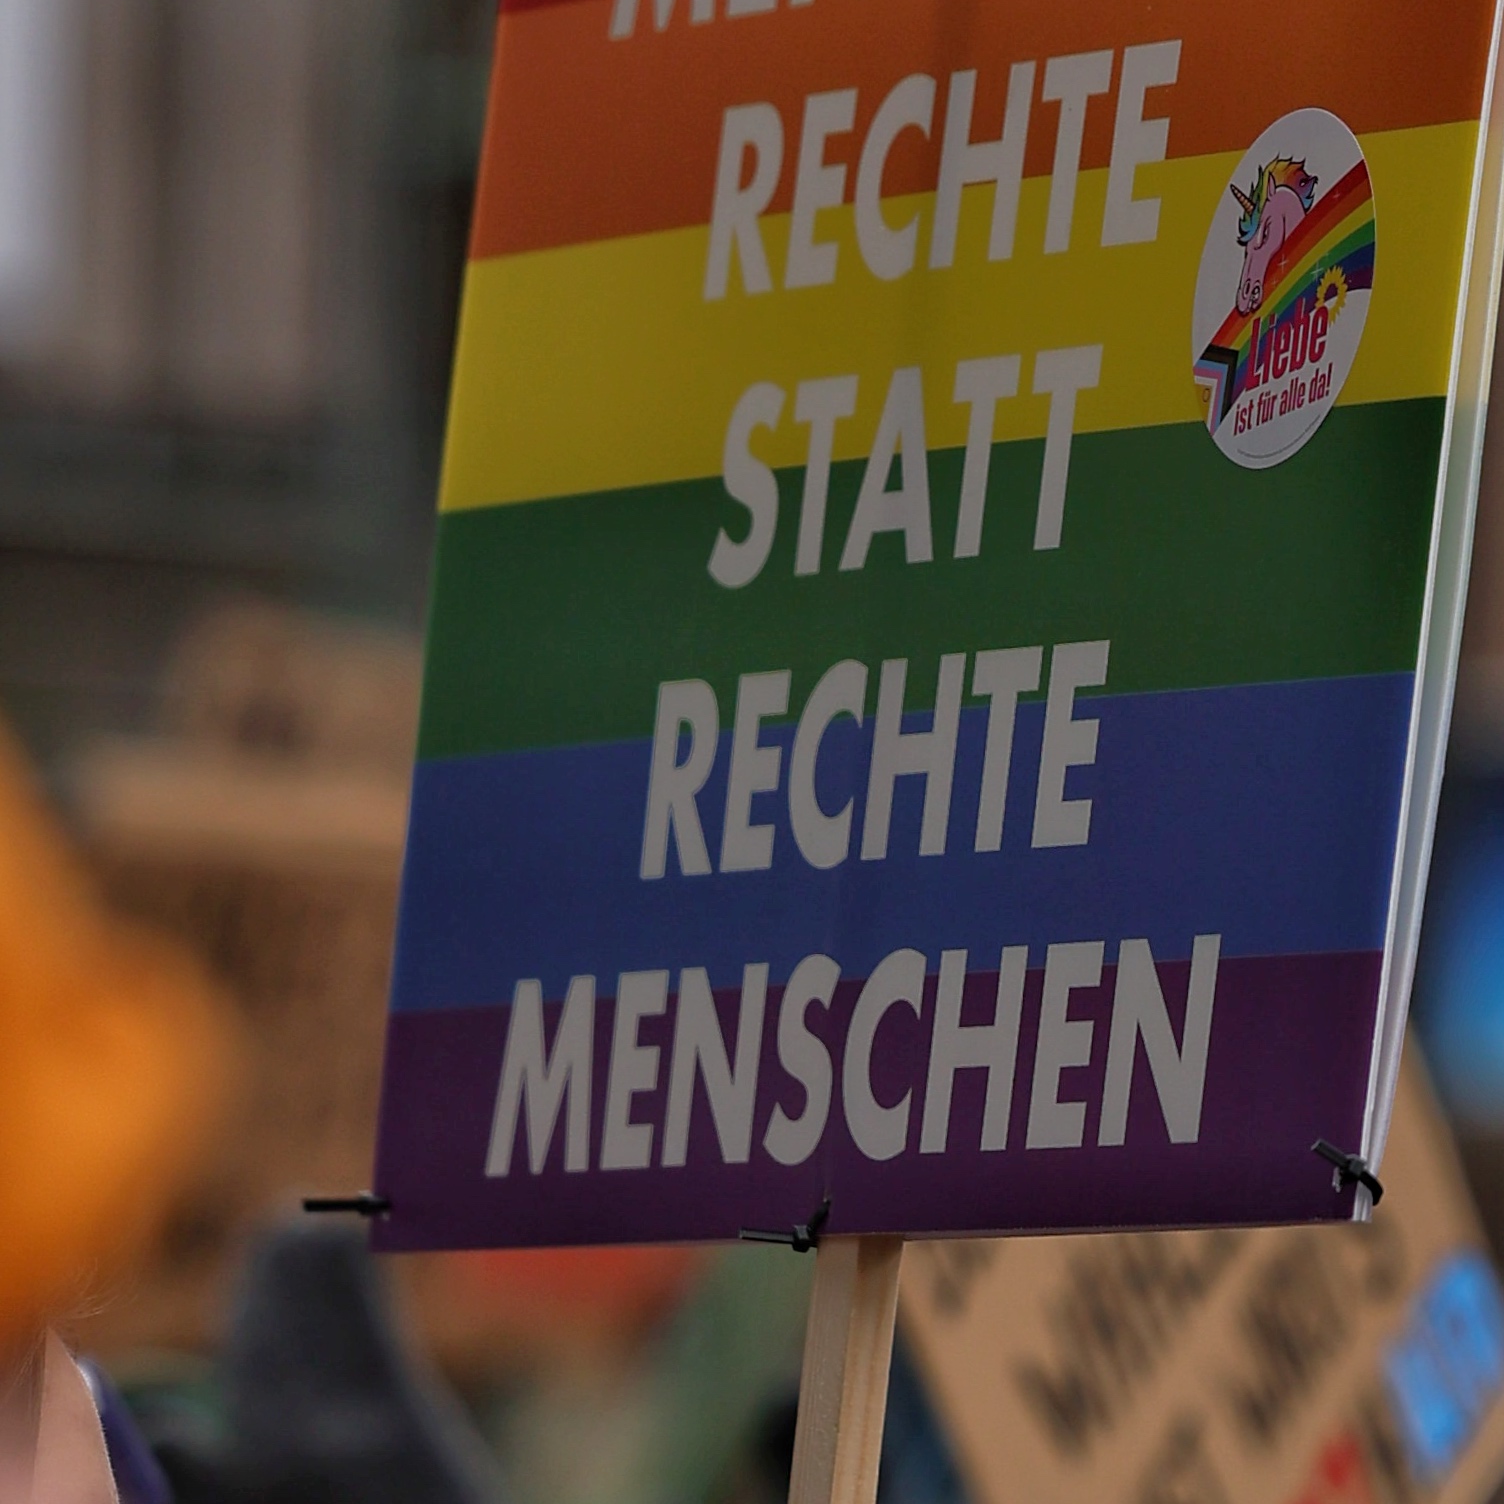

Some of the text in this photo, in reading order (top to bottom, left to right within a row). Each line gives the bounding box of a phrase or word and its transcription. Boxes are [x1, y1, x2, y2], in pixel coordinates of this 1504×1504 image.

[703, 40, 1182, 299] RECHTE
[1234, 363, 1333, 436] ist für alle da!
[1245, 297, 1329, 391] Liebe
[705, 345, 1103, 590] STATT
[639, 638, 1111, 880] RECHTE
[483, 932, 1222, 1179] MENSCHEN
